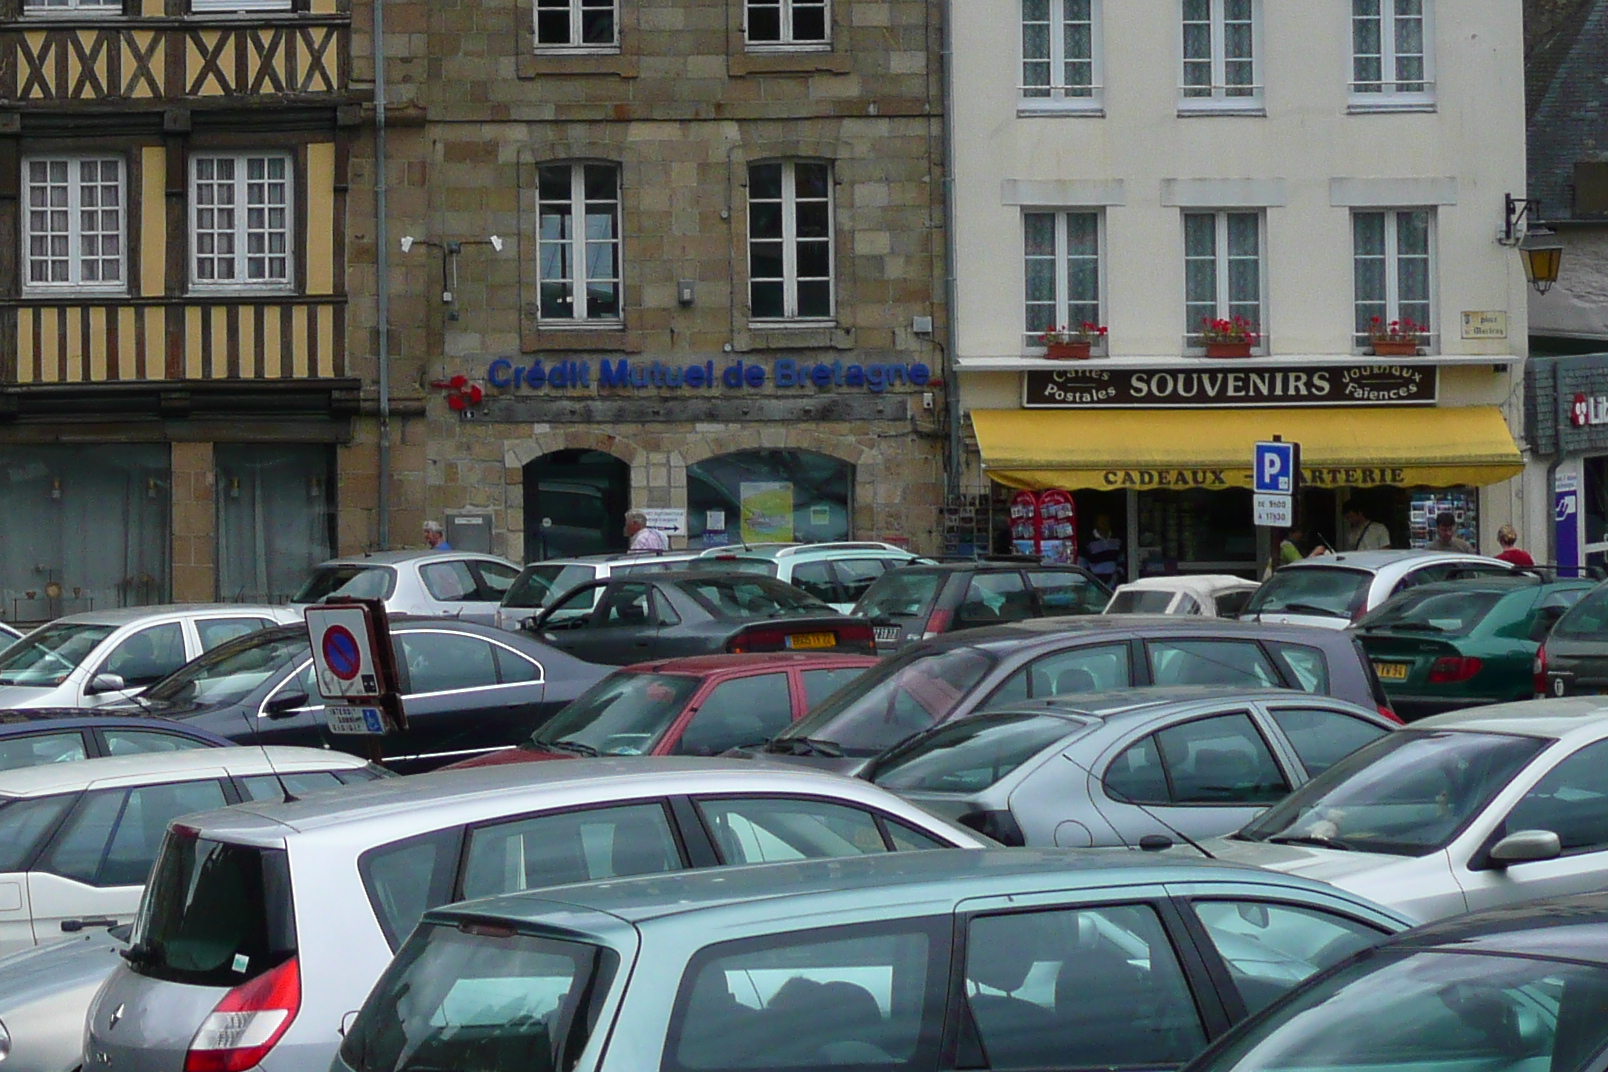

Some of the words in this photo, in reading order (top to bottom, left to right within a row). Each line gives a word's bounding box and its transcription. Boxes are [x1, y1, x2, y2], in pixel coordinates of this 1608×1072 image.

[488, 358, 590, 388] Crédit
[599, 358, 714, 388] Mutuel
[723, 359, 766, 388] de
[775, 358, 931, 392] Bretagne
[1053, 369, 1111, 382] Cartes
[1130, 371, 1331, 397] SOUVENIRS
[1044, 383, 1117, 403] Postales
[1344, 382, 1418, 400] Faïences
[1103, 471, 1227, 485] CADEAUX
[1299, 468, 1405, 484] ARTERIE
[1264, 453, 1281, 483] P
